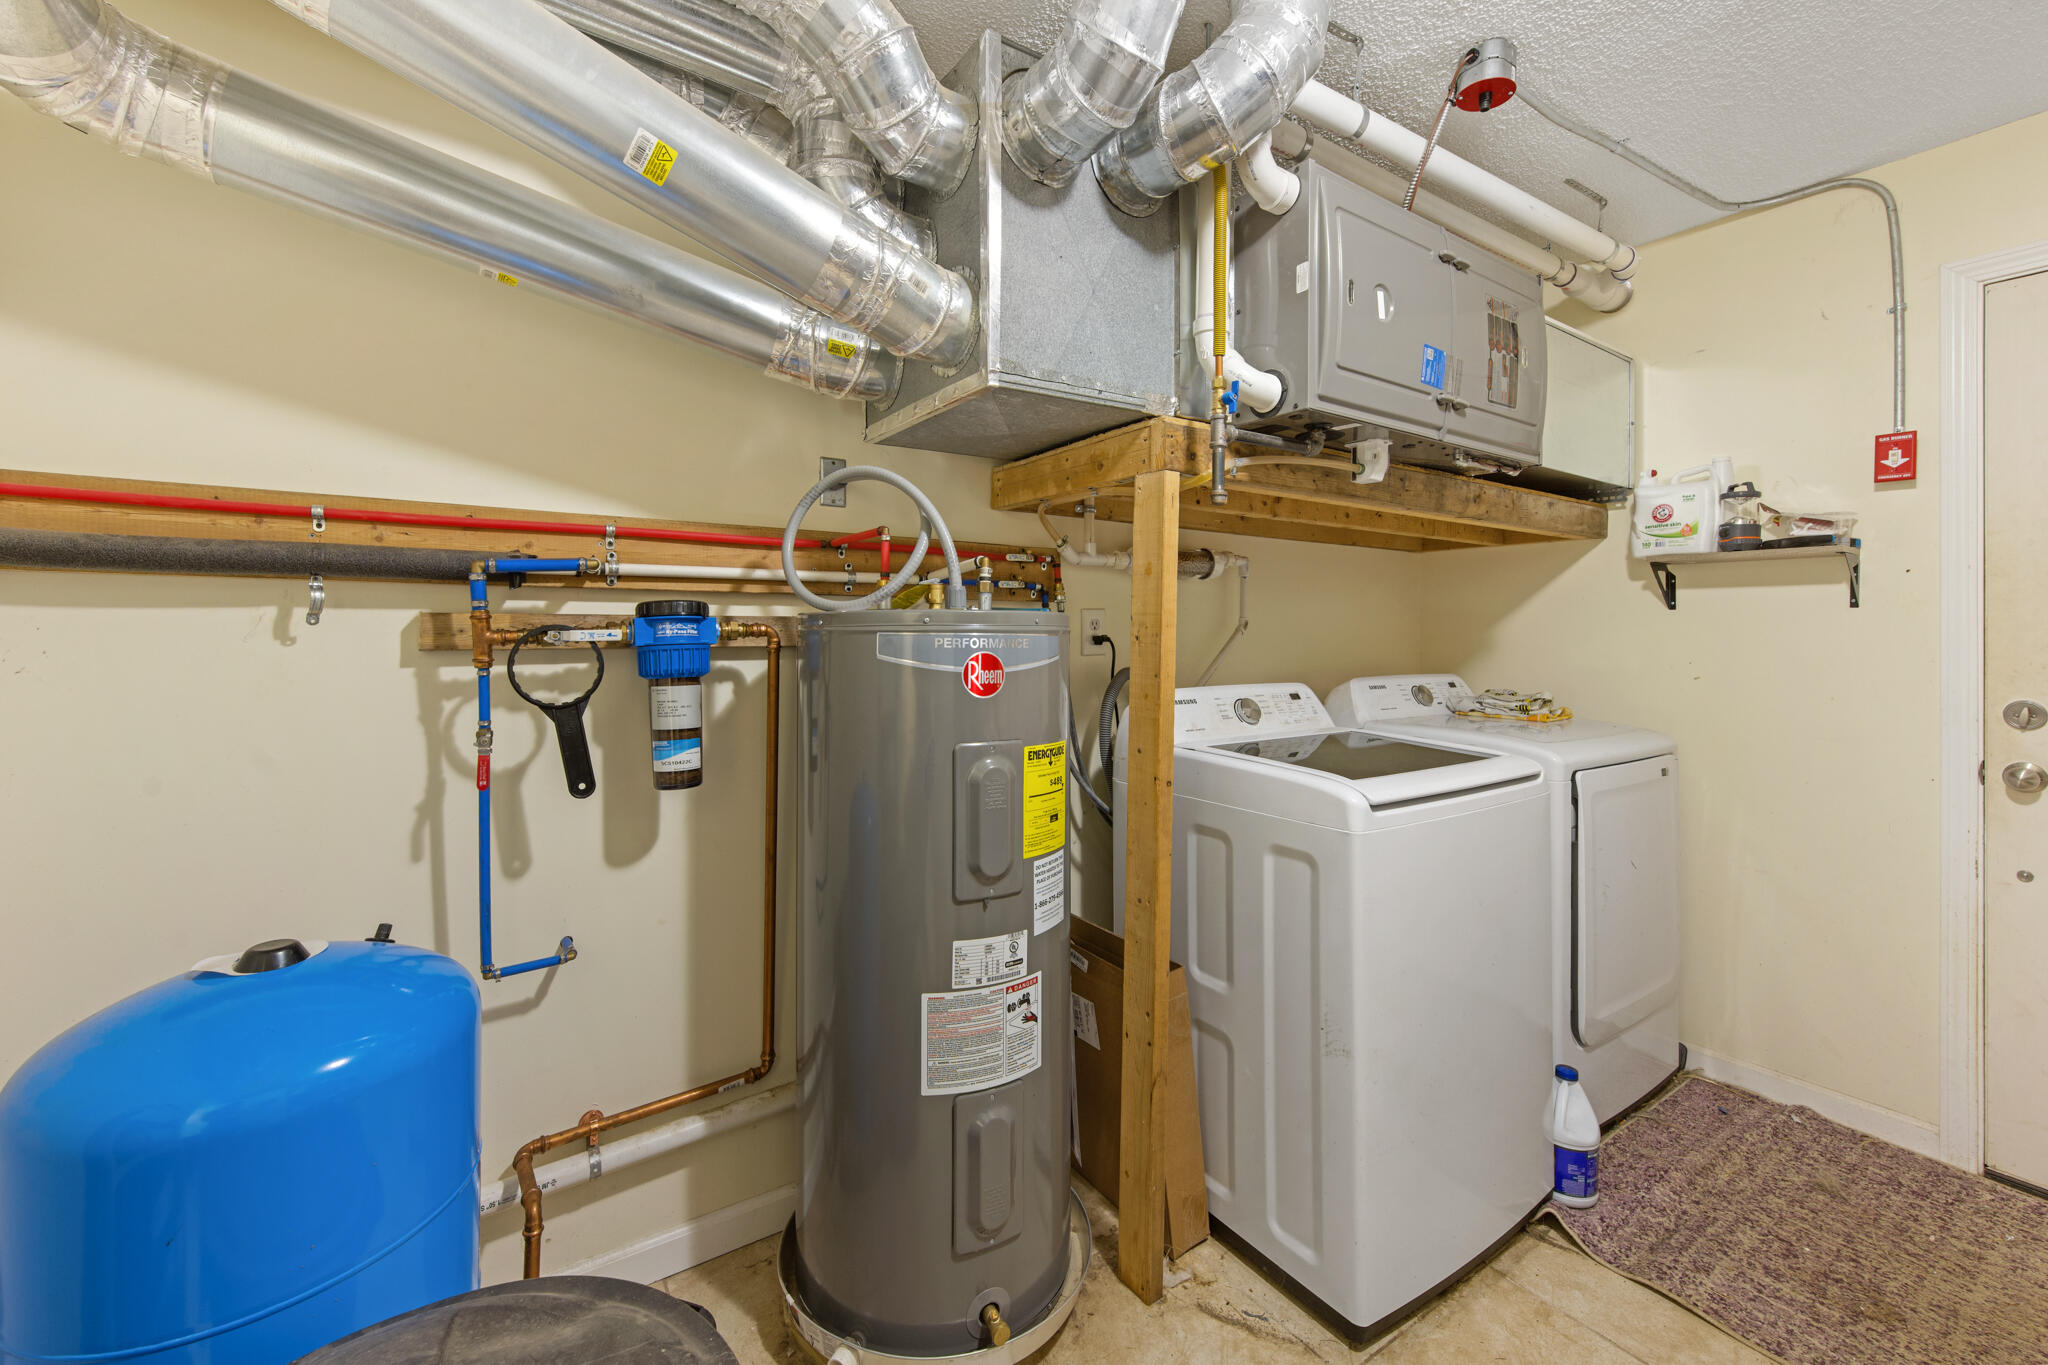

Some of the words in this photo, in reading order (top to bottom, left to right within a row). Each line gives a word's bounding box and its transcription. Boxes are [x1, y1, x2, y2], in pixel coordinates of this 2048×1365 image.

[934, 637, 1029, 649] PERFORMANCE
[967, 652, 1003, 691] Rheem
[1175, 698, 1198, 706] AMSUNG
[1014, 976, 1038, 992] DANGER
